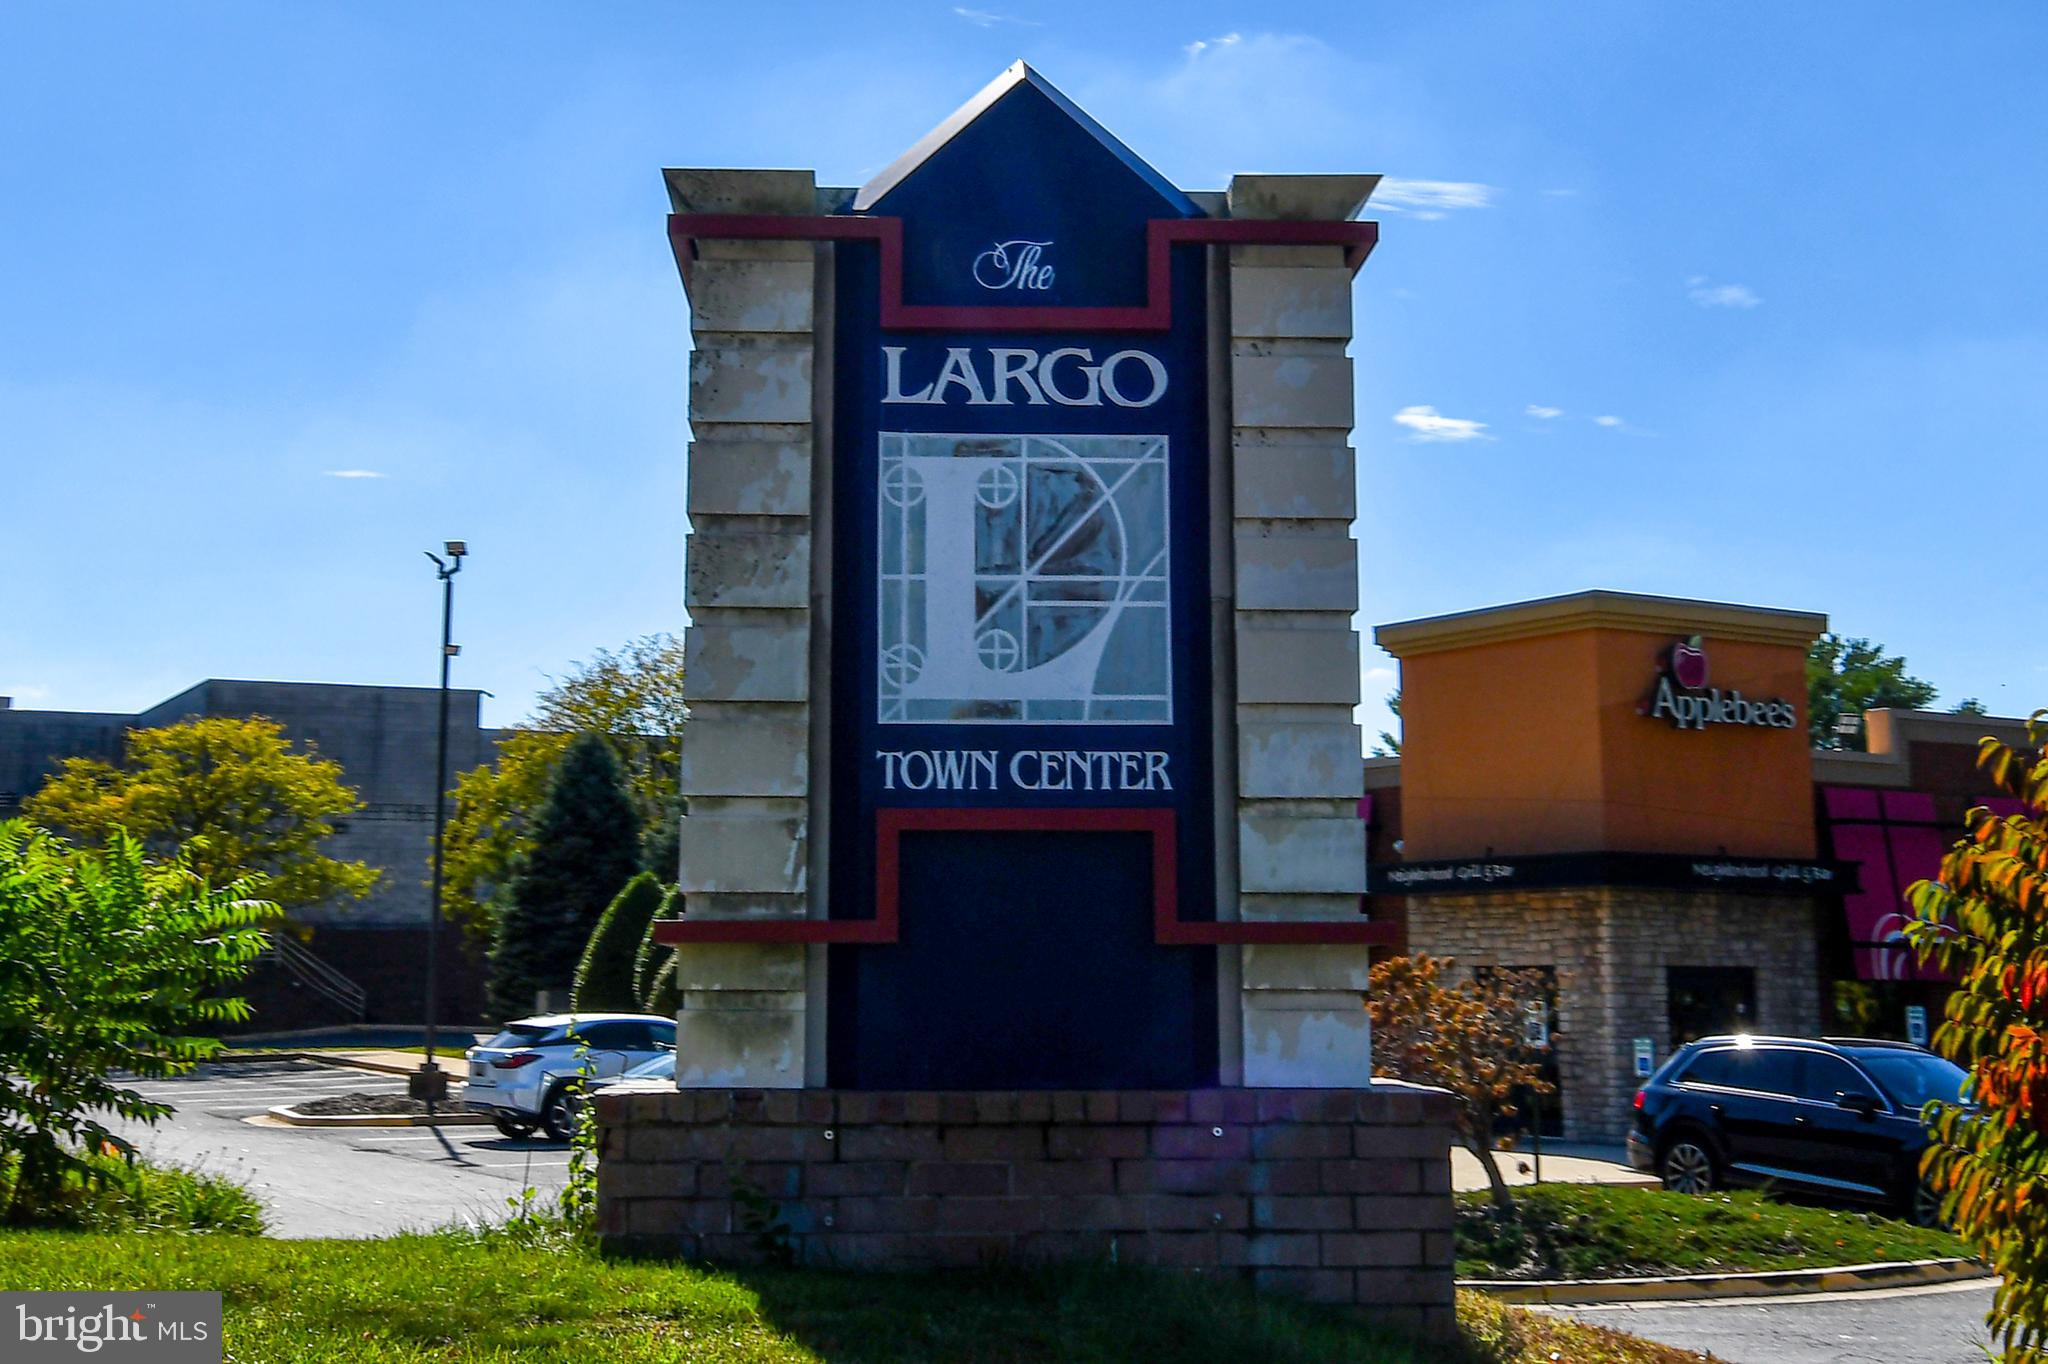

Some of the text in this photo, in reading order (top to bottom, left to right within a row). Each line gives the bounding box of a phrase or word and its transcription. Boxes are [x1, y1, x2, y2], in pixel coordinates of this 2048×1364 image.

[972, 240, 1055, 290] The
[880, 345, 1169, 408] LARGO
[875, 749, 1174, 791] TOWN CENTER
